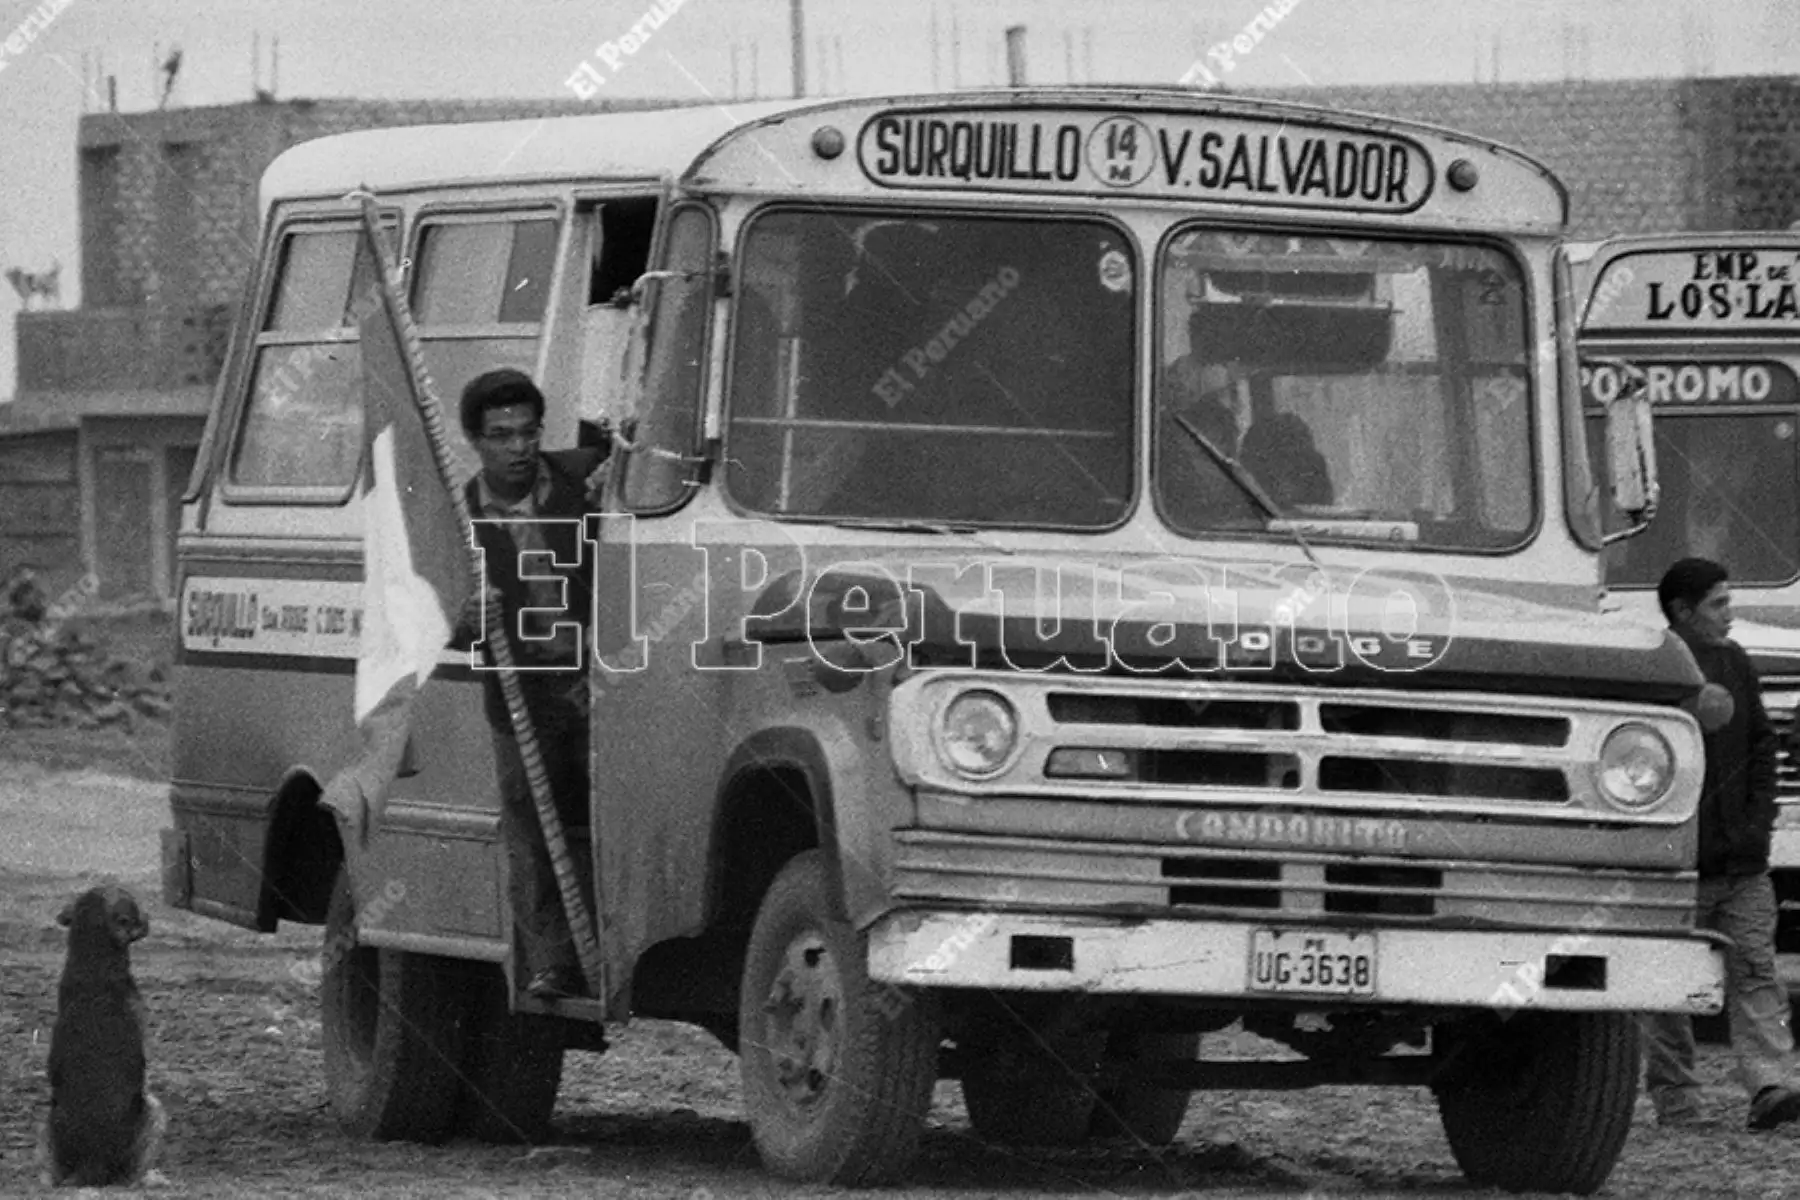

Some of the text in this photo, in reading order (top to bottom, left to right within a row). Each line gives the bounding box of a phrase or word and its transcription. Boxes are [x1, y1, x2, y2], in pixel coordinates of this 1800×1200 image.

[876, 117, 1081, 182] SURQUILLO
[1106, 123, 1138, 161] 14
[1256, 951, 1370, 987] UG-3638
